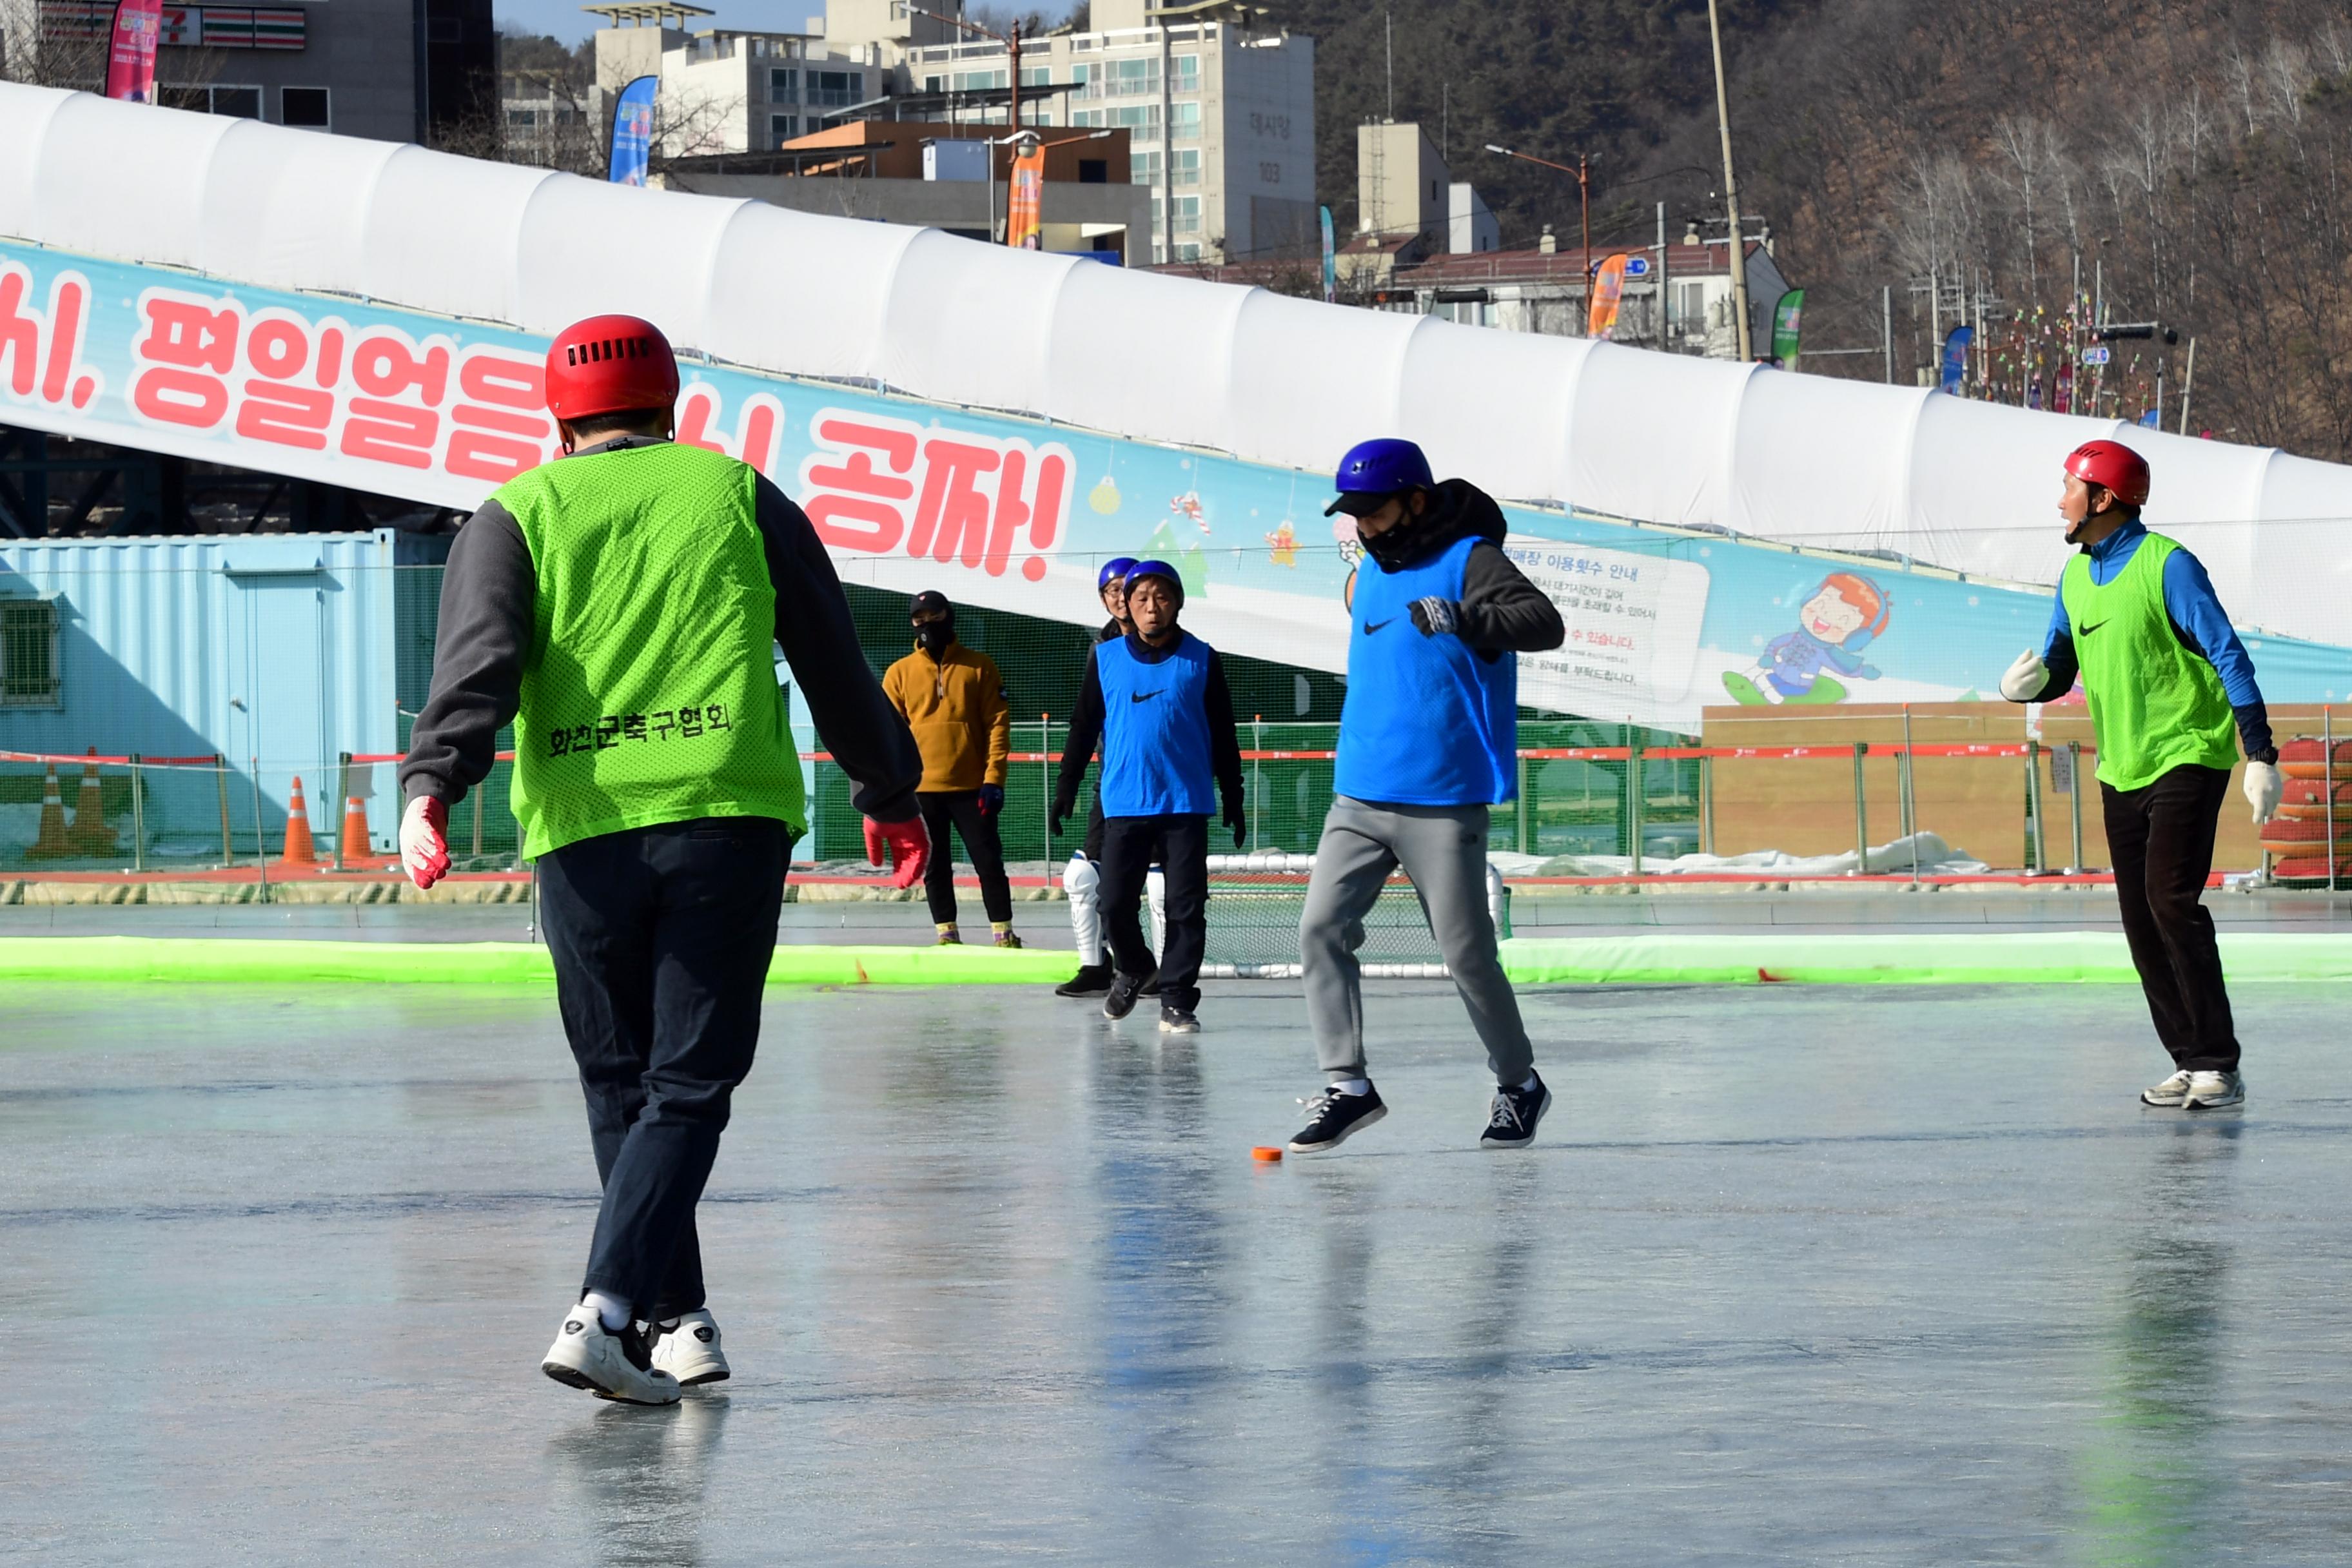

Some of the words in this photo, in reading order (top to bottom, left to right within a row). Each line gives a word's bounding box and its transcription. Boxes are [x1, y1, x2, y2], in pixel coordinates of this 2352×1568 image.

[1260, 162, 1280, 183] 103
[805, 419, 1066, 582] 공짜!
[1547, 555, 1603, 576] 이용횟수
[1609, 564, 1638, 582] 안내
[1554, 581, 1602, 598] 대기시간이
[1605, 588, 1623, 601] 길어
[1615, 605, 1625, 614] 수
[1627, 606, 1656, 620] 있어서
[1571, 629, 1583, 641] 수
[1586, 631, 1635, 650] 있습니다.
[1574, 666, 1637, 686] 부탁드립니다.
[549, 702, 732, 758] 화천군축구협회
